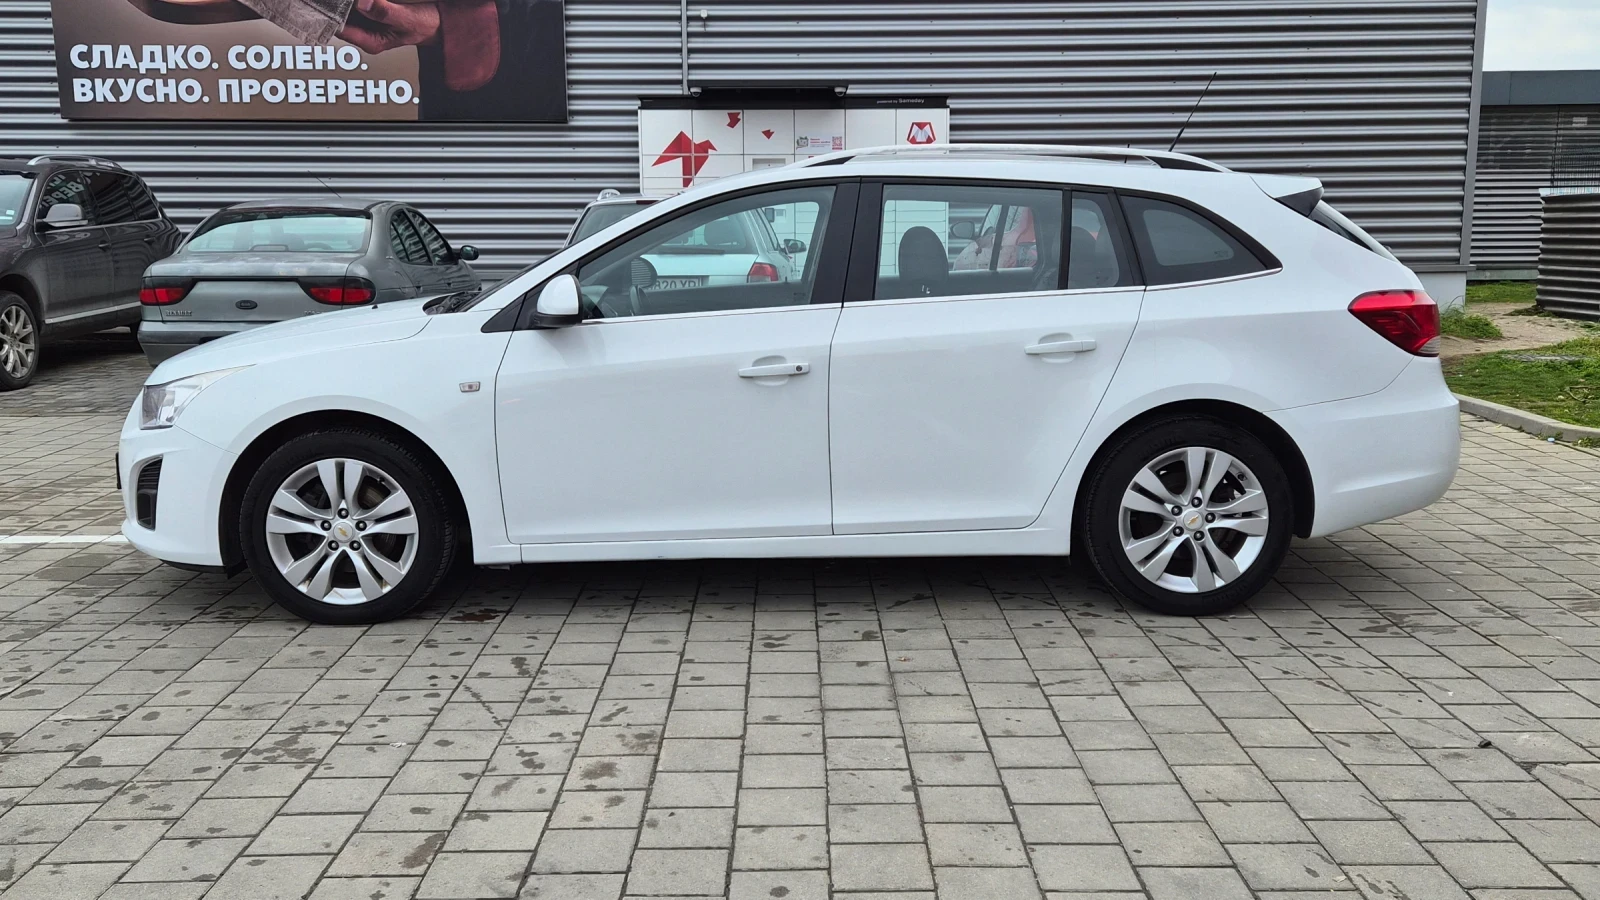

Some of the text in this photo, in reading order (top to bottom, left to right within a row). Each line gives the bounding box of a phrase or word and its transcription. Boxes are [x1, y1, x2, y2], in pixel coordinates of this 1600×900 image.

[70, 44, 369, 74] СЛАДКО. СОЛЕНО.
[72, 78, 420, 104] ВКУСНО. ПРОВЕРЕНО.
[898, 97, 925, 105] Sameday
